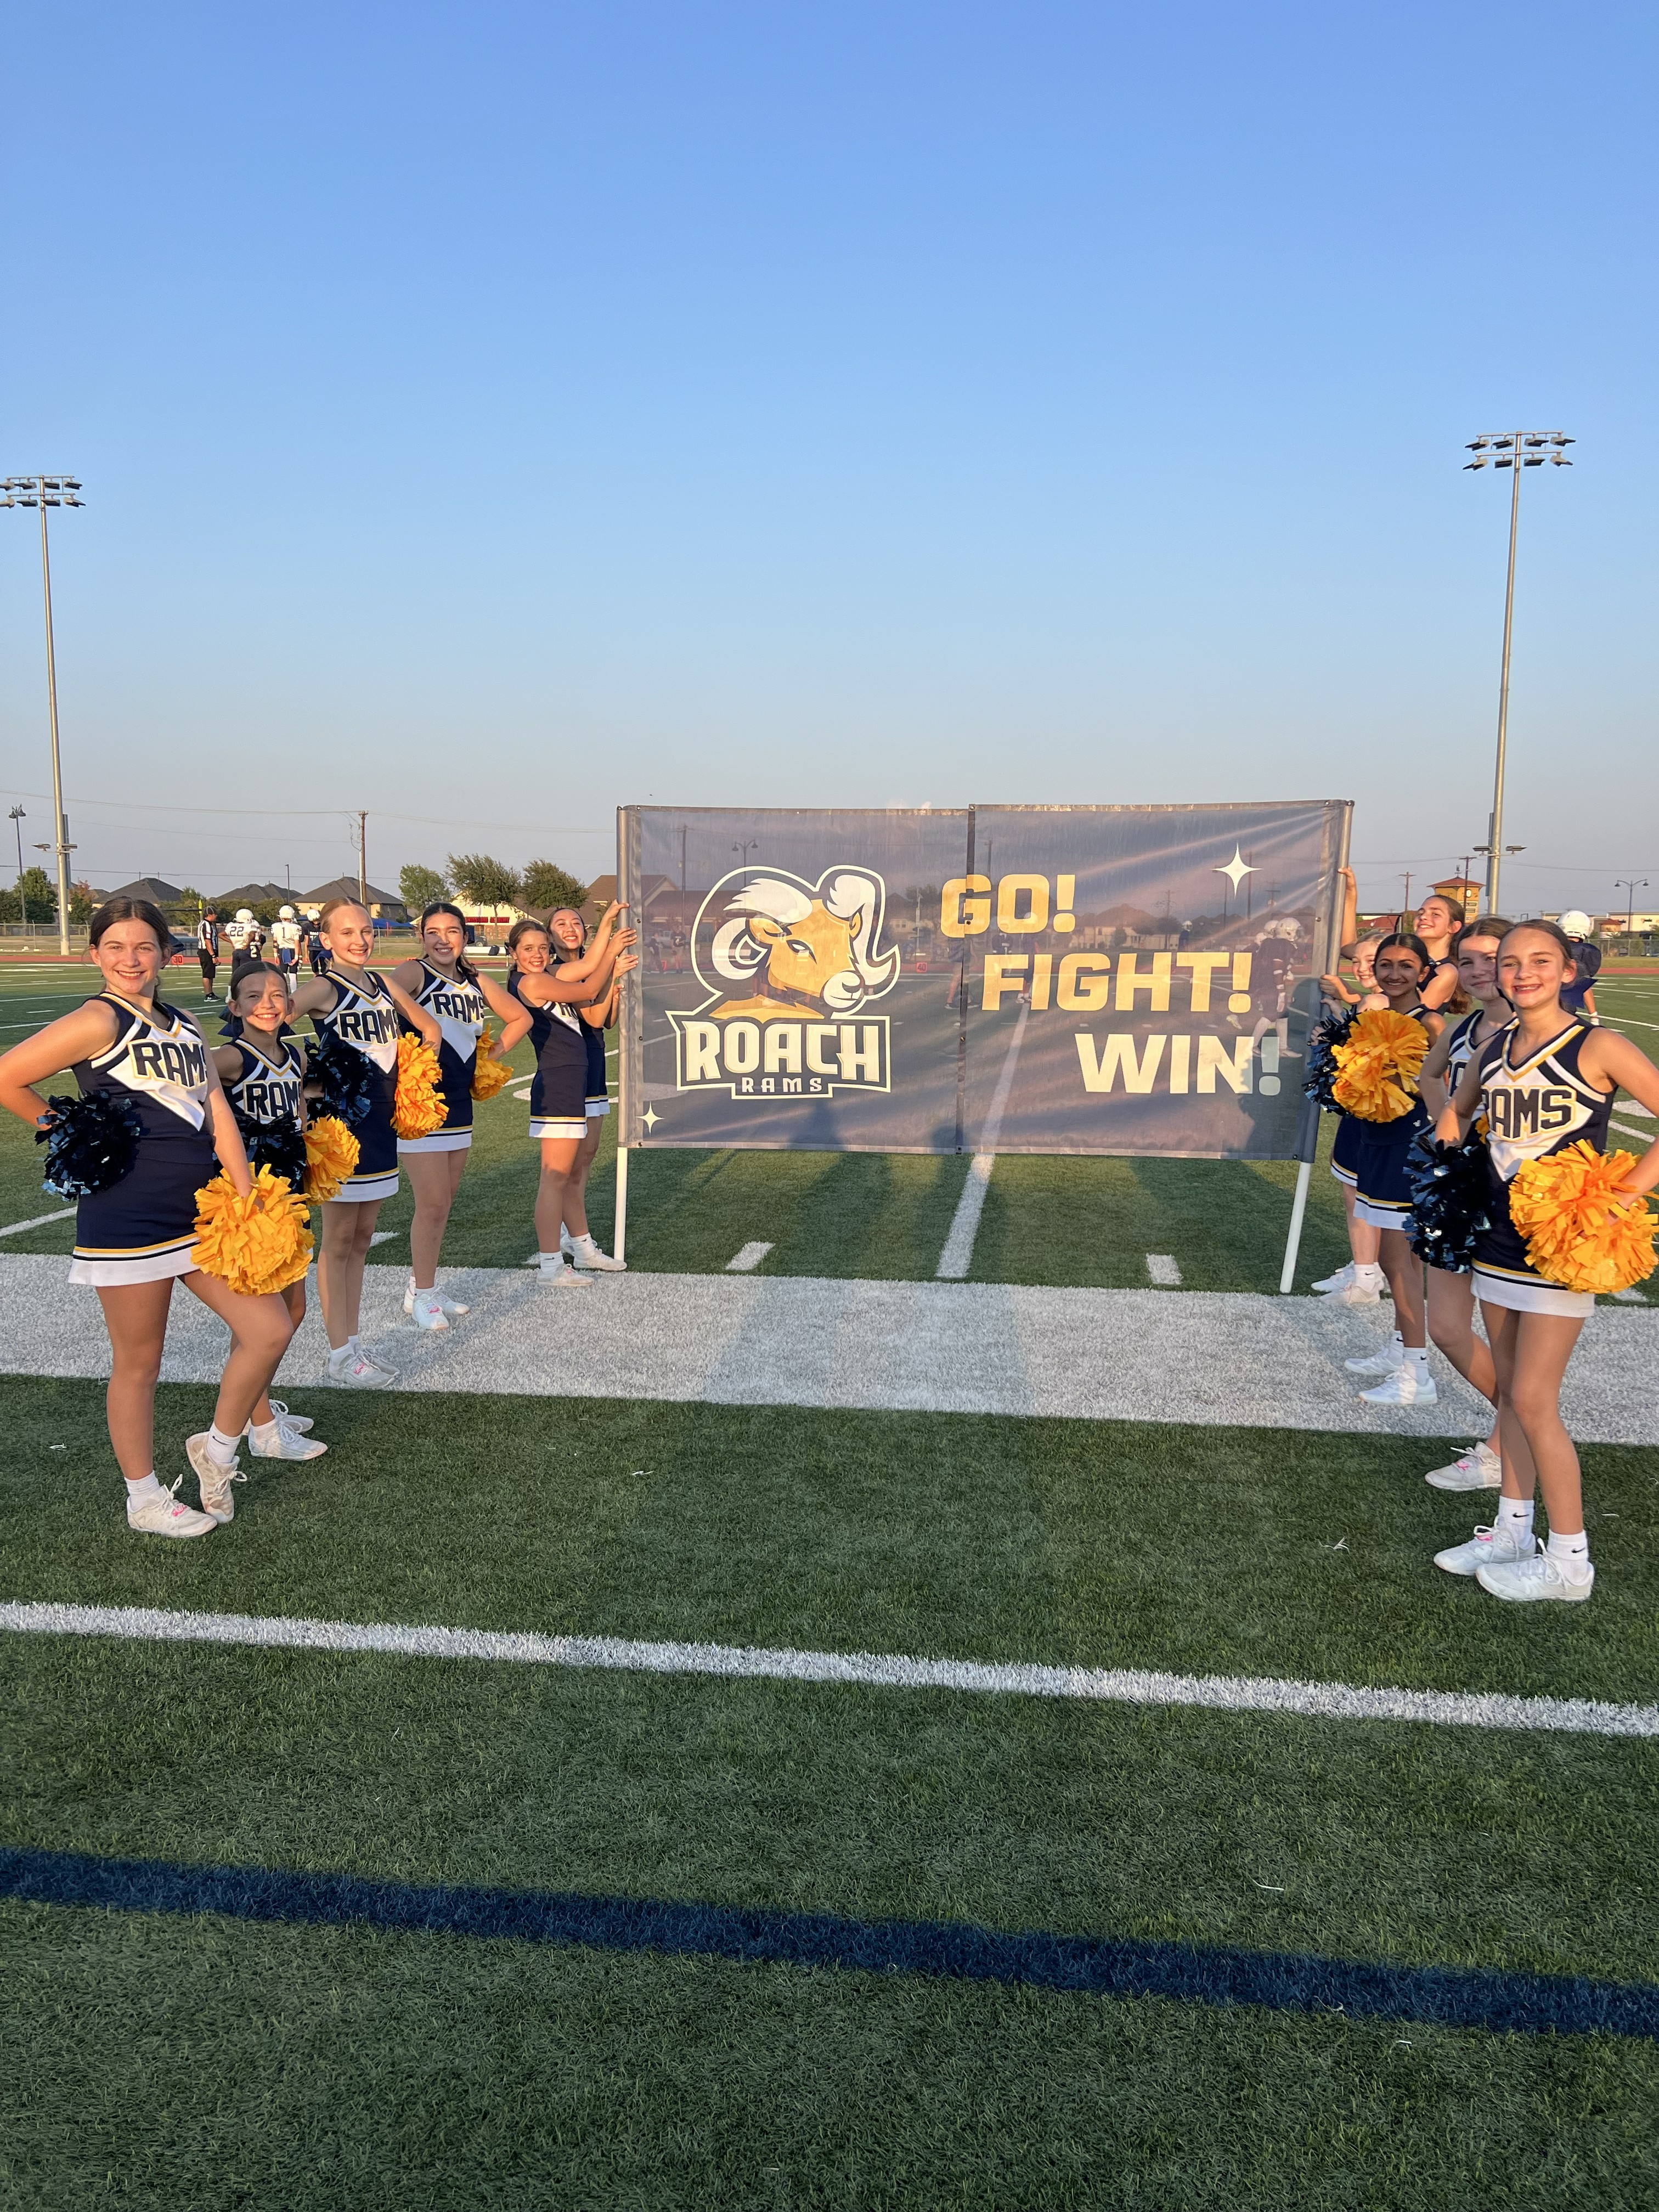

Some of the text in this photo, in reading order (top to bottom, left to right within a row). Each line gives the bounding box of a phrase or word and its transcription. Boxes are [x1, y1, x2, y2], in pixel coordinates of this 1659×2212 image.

[940, 874, 1076, 938] GO!
[229, 926, 244, 937] 22
[281, 927, 286, 939] 1
[250, 945, 257, 958] 2
[981, 952, 1253, 1014] FIGHT!
[338, 1008, 398, 1045] RAM
[130, 1041, 207, 1088] RAM
[681, 1020, 879, 1082] ROACH
[1075, 1033, 1281, 1096] WIN!
[245, 1080, 302, 1119] RAM
[741, 1076, 822, 1093] RAMS
